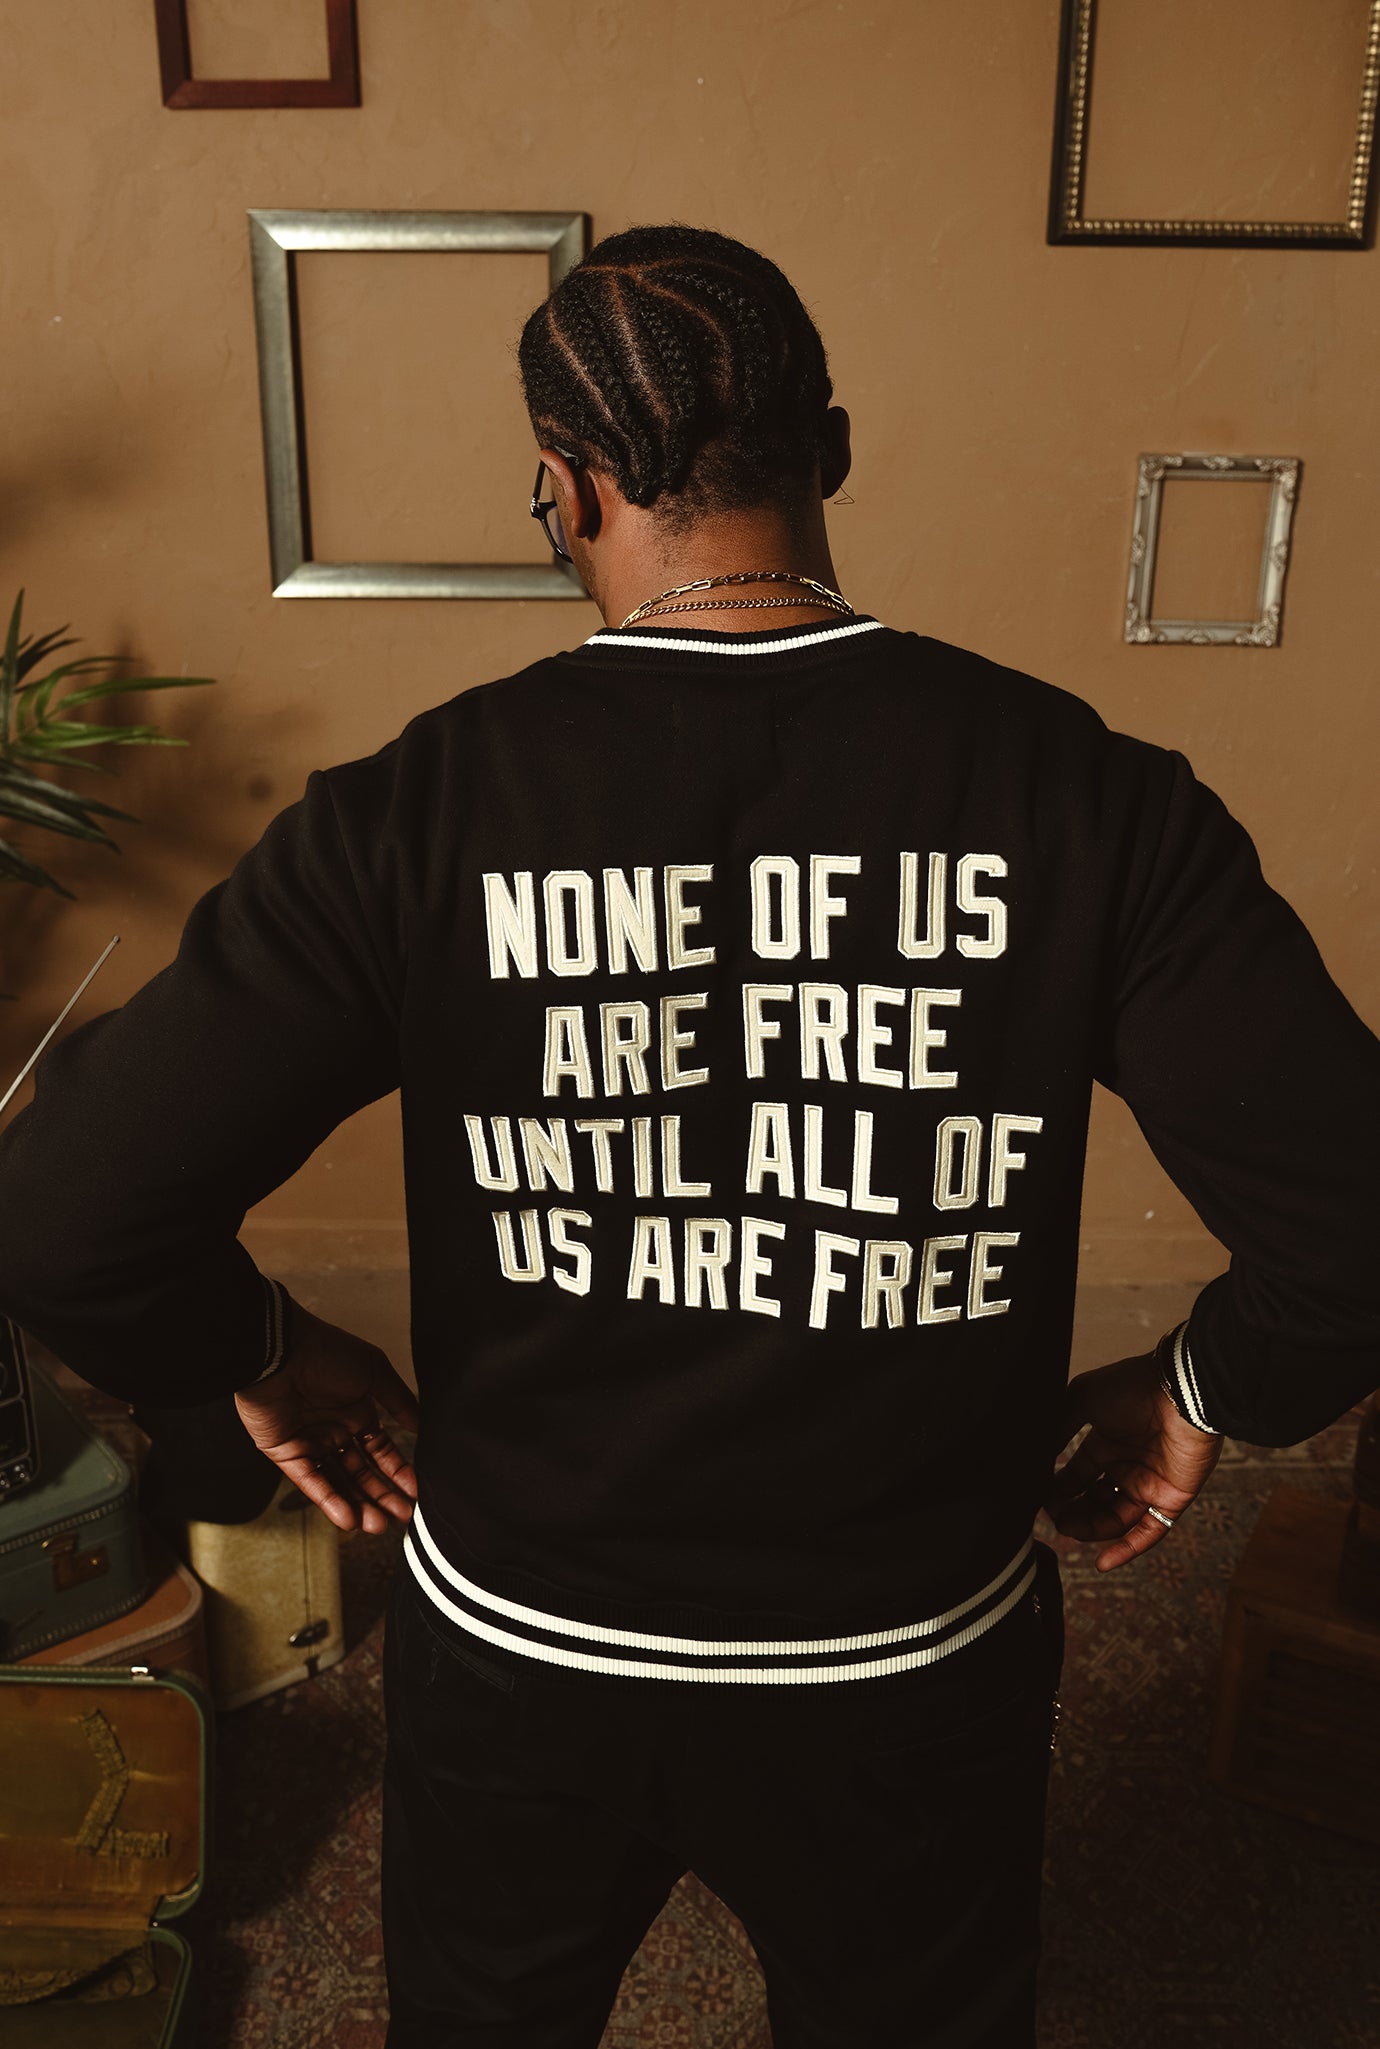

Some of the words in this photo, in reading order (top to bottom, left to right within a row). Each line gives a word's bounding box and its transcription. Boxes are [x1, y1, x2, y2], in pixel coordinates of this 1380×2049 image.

[482, 865, 716, 979] NONE
[750, 854, 861, 960] OF
[897, 852, 1008, 960] US
[543, 991, 709, 1098] ARE
[742, 982, 963, 1090] FREE
[463, 1114, 711, 1198] UNTIL
[746, 1102, 899, 1215] ALL
[933, 1113, 1043, 1211] OF
[492, 1207, 592, 1297] US
[627, 1216, 786, 1318] ARE
[809, 1230, 1021, 1330] FREE
